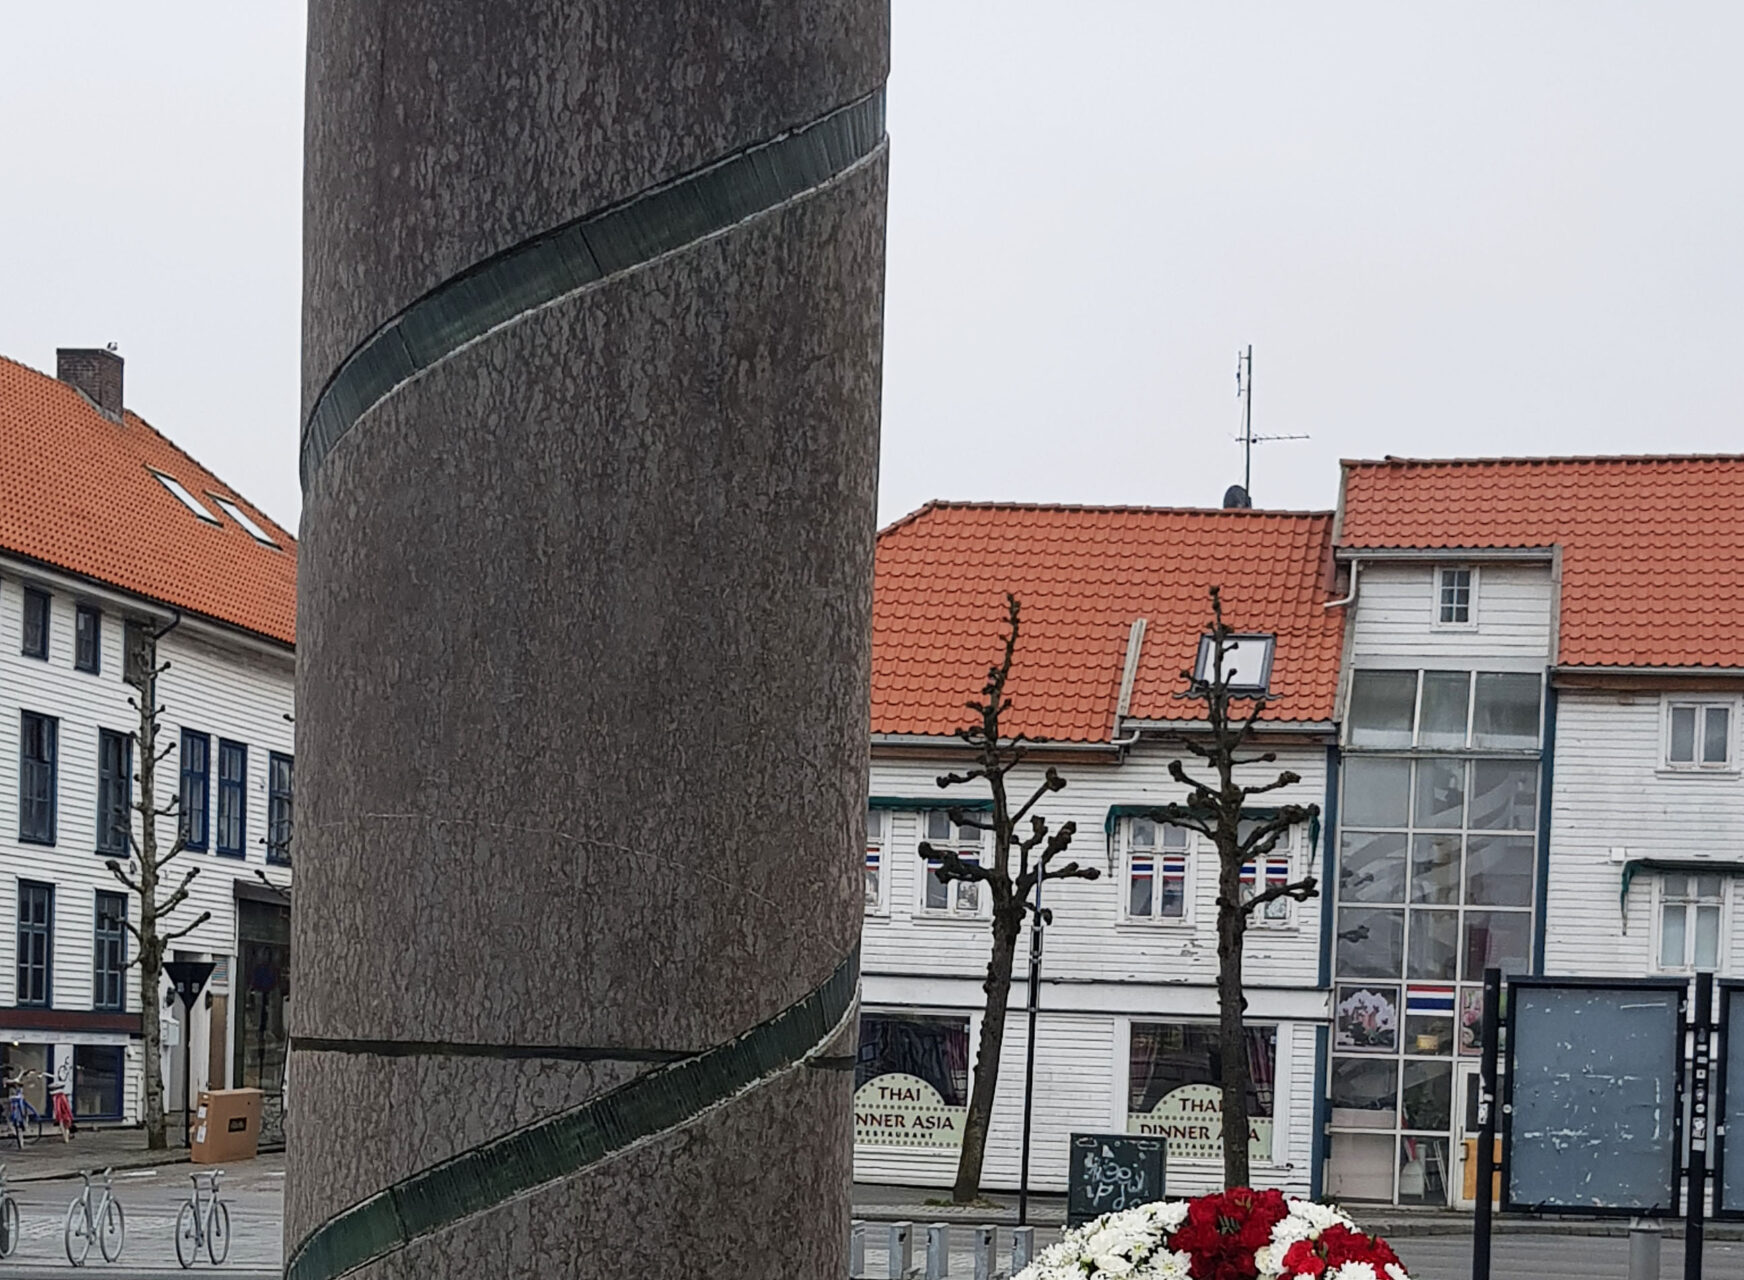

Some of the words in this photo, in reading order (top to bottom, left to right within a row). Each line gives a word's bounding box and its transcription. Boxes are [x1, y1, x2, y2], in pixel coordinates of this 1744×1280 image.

[878, 1086, 921, 1102] THAI
[854, 1112, 906, 1128] NNER
[912, 1115, 954, 1130] ASIA
[857, 1130, 933, 1139] RESTAURANT
[1168, 1142, 1222, 1151] ESTAURA
